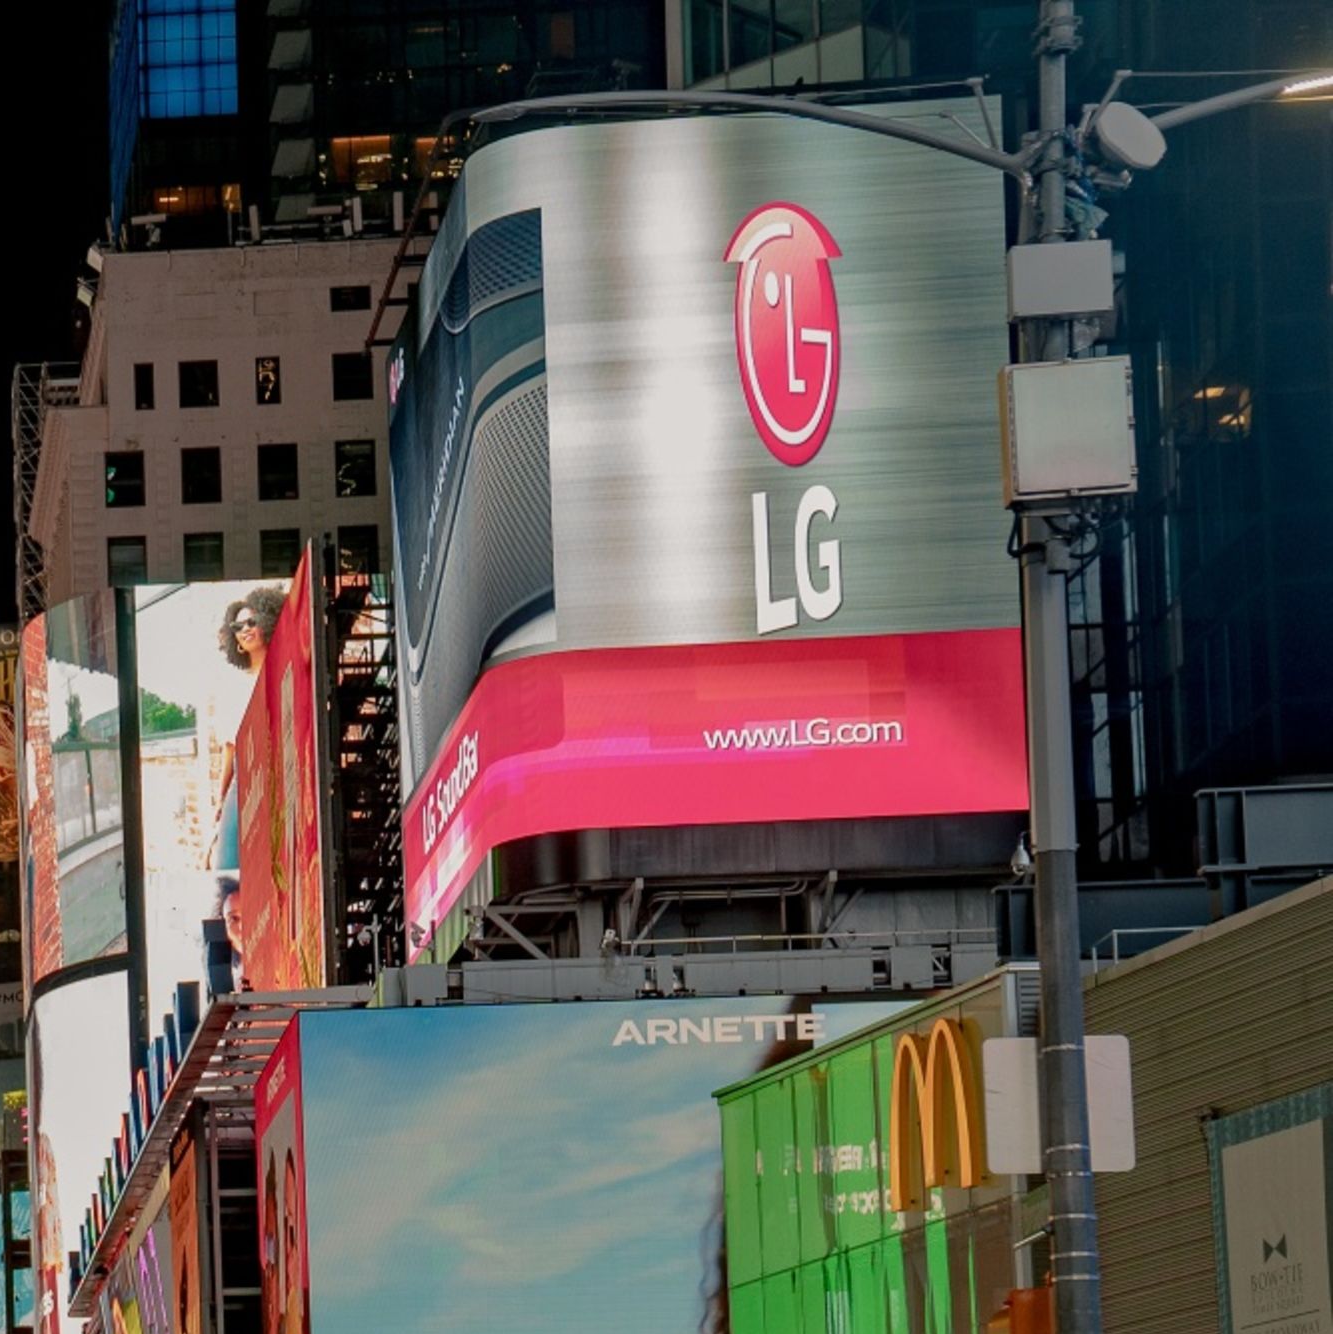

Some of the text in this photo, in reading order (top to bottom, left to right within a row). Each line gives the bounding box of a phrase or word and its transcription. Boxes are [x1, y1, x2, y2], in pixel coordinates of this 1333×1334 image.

[753, 485, 843, 636] LG
[703, 717, 903, 751] www.LG.com
[421, 805, 435, 855] LG
[611, 1013, 826, 1047] ARNETTE
